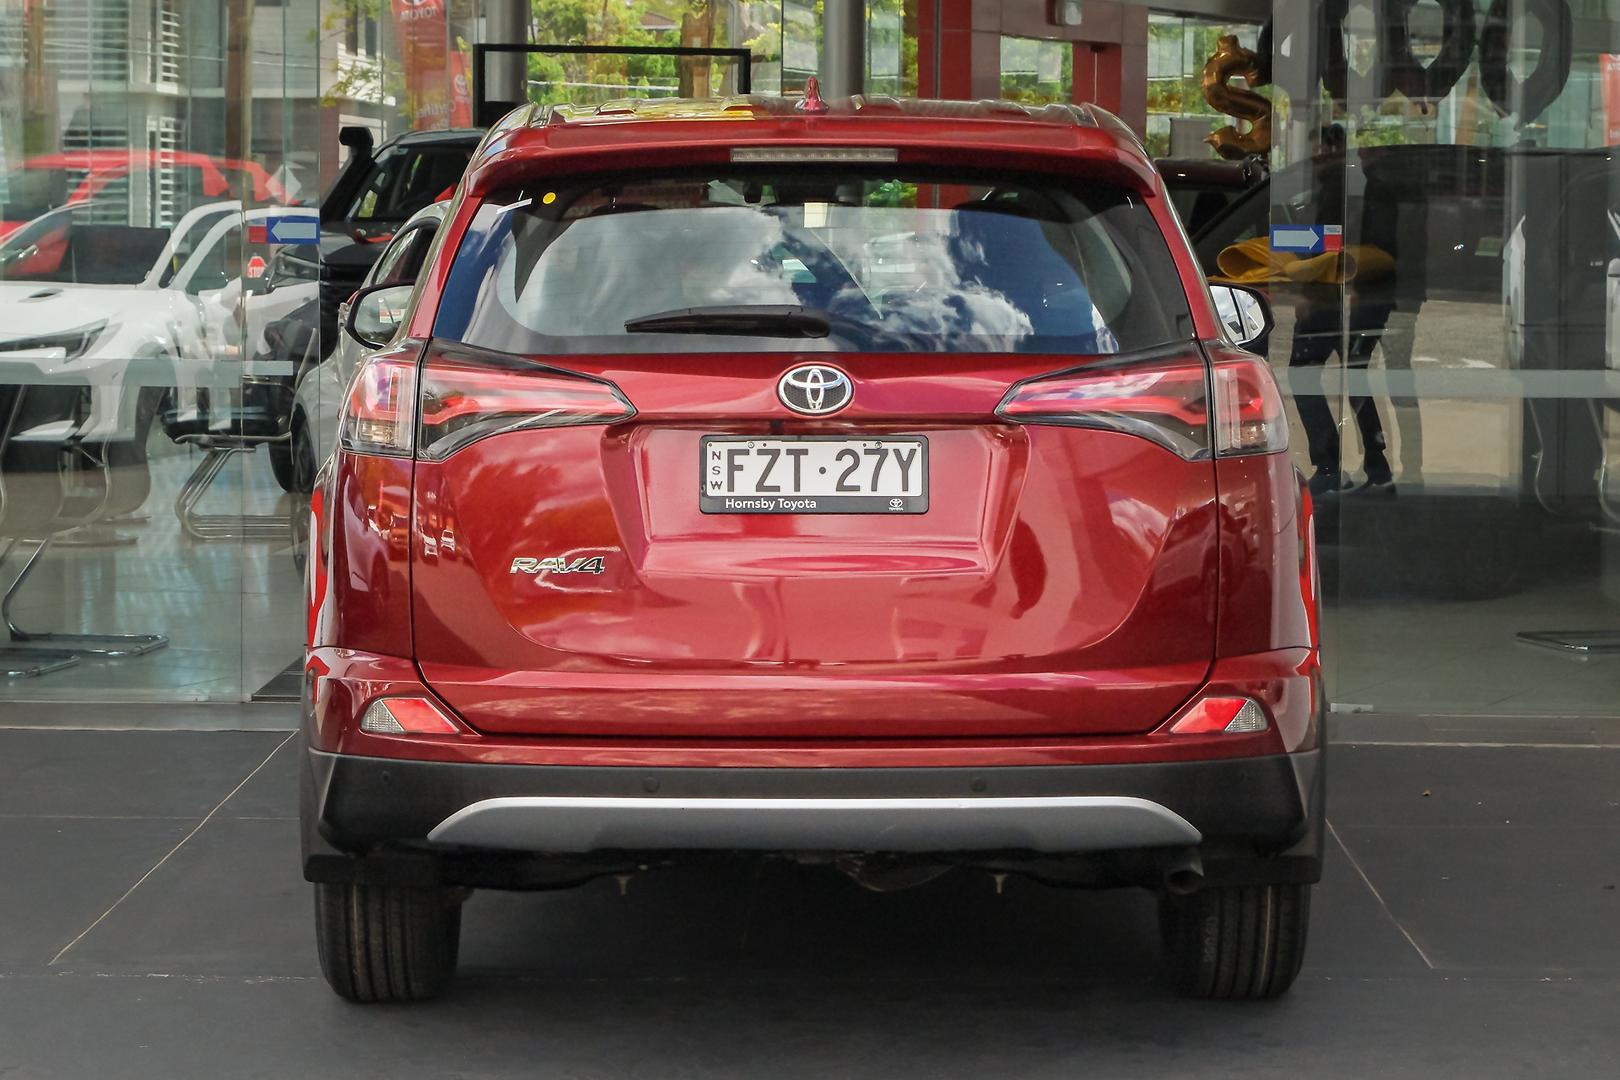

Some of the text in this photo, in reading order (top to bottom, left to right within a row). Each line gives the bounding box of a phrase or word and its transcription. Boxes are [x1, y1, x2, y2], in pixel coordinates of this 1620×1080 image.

[725, 498, 817, 511] Hornsby Toyota
[510, 556, 605, 574] RAV4
